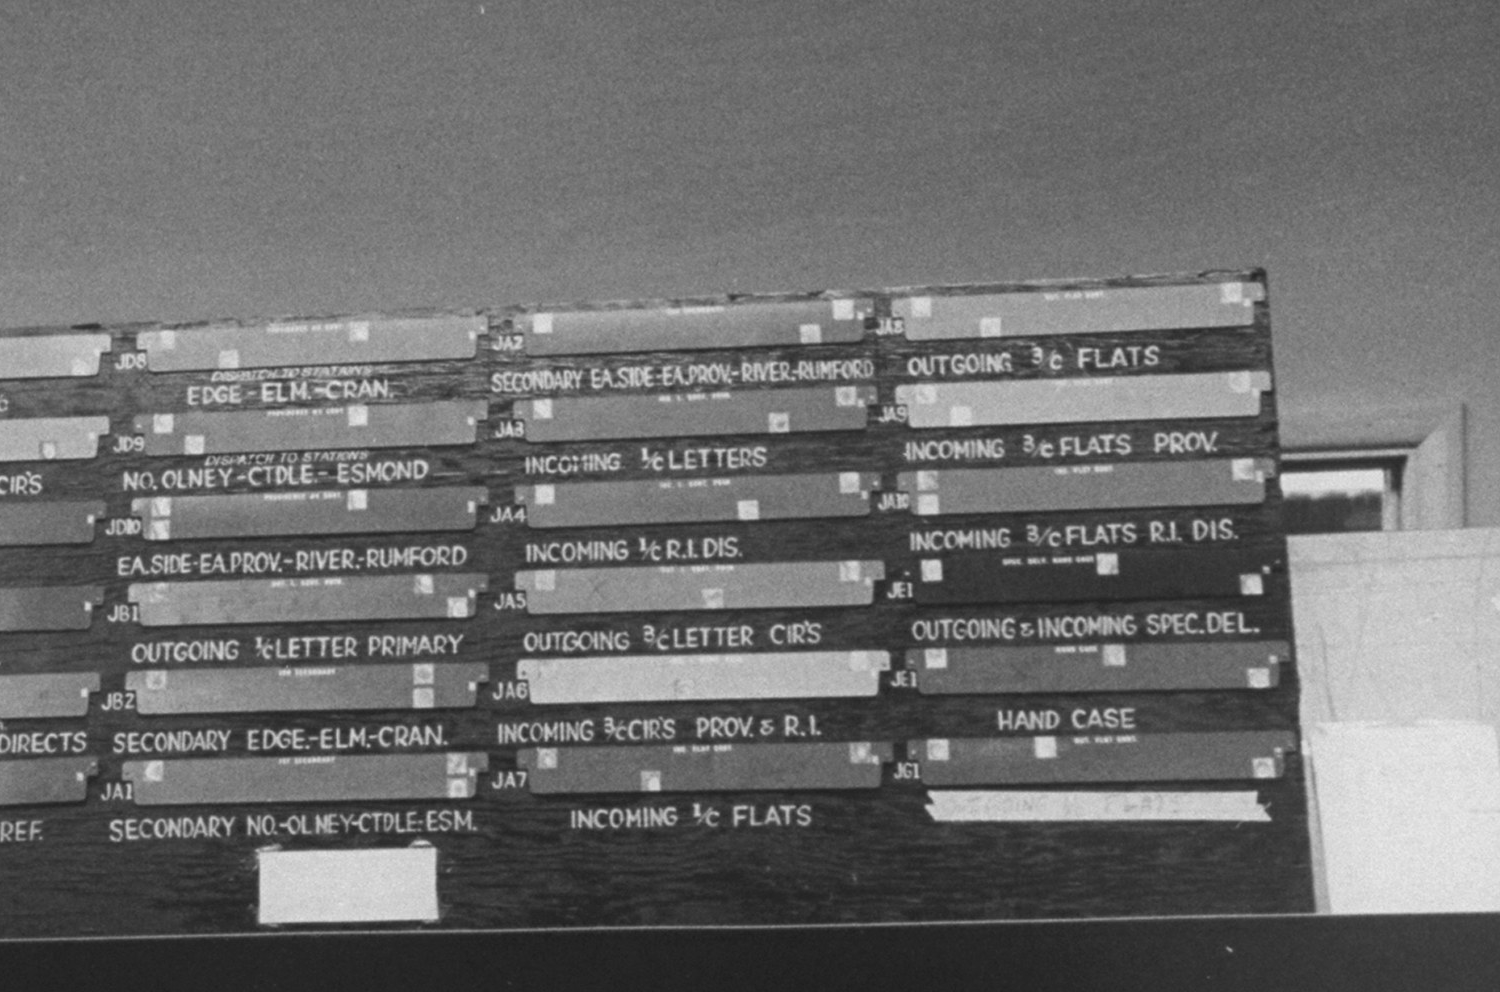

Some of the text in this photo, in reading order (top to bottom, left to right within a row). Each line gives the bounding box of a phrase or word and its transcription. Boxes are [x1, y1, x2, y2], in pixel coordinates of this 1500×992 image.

[115, 353, 147, 370] JD8
[908, 353, 1012, 376] OUTGOING
[1077, 346, 1160, 368] FLATS
[492, 369, 583, 393] SECONDARY
[495, 421, 524, 438] JA3
[113, 437, 145, 453] JD9
[904, 439, 1005, 461] INCOMING
[1060, 434, 1131, 456] FLATS
[1154, 431, 1217, 453] PROV.
[205, 451, 369, 467] DISPATCH TO STATIONS
[525, 453, 621, 475] INCOMING
[667, 446, 768, 470] LETTERS
[490, 507, 527, 523] JA4
[910, 528, 1011, 551] INCOMING
[1065, 523, 1136, 546] FLATS
[1193, 519, 1238, 540] DIS.
[526, 540, 629, 562] INCOMING
[703, 537, 743, 558] DIS.
[494, 593, 526, 610] JA5
[107, 605, 139, 623] JB1
[131, 640, 240, 663] OUTGOING
[276, 636, 357, 659] LETTER
[368, 634, 464, 657] PRIMARY
[524, 630, 630, 652] OUTGOING
[672, 625, 754, 648] LETTER
[101, 693, 136, 711] JB2
[492, 682, 528, 700] JA6
[498, 719, 594, 744] INCOMING
[697, 716, 754, 738] PROV.
[760, 719, 774, 735] &
[785, 715, 821, 736] R.I.
[999, 709, 1136, 730] HAND CASE
[113, 730, 231, 753] SECONDARY
[492, 772, 526, 788] JA7
[101, 783, 133, 801] JA1
[571, 807, 677, 829] INCOMING
[733, 804, 812, 827] FLATS
[109, 816, 236, 842] SECONDARY
